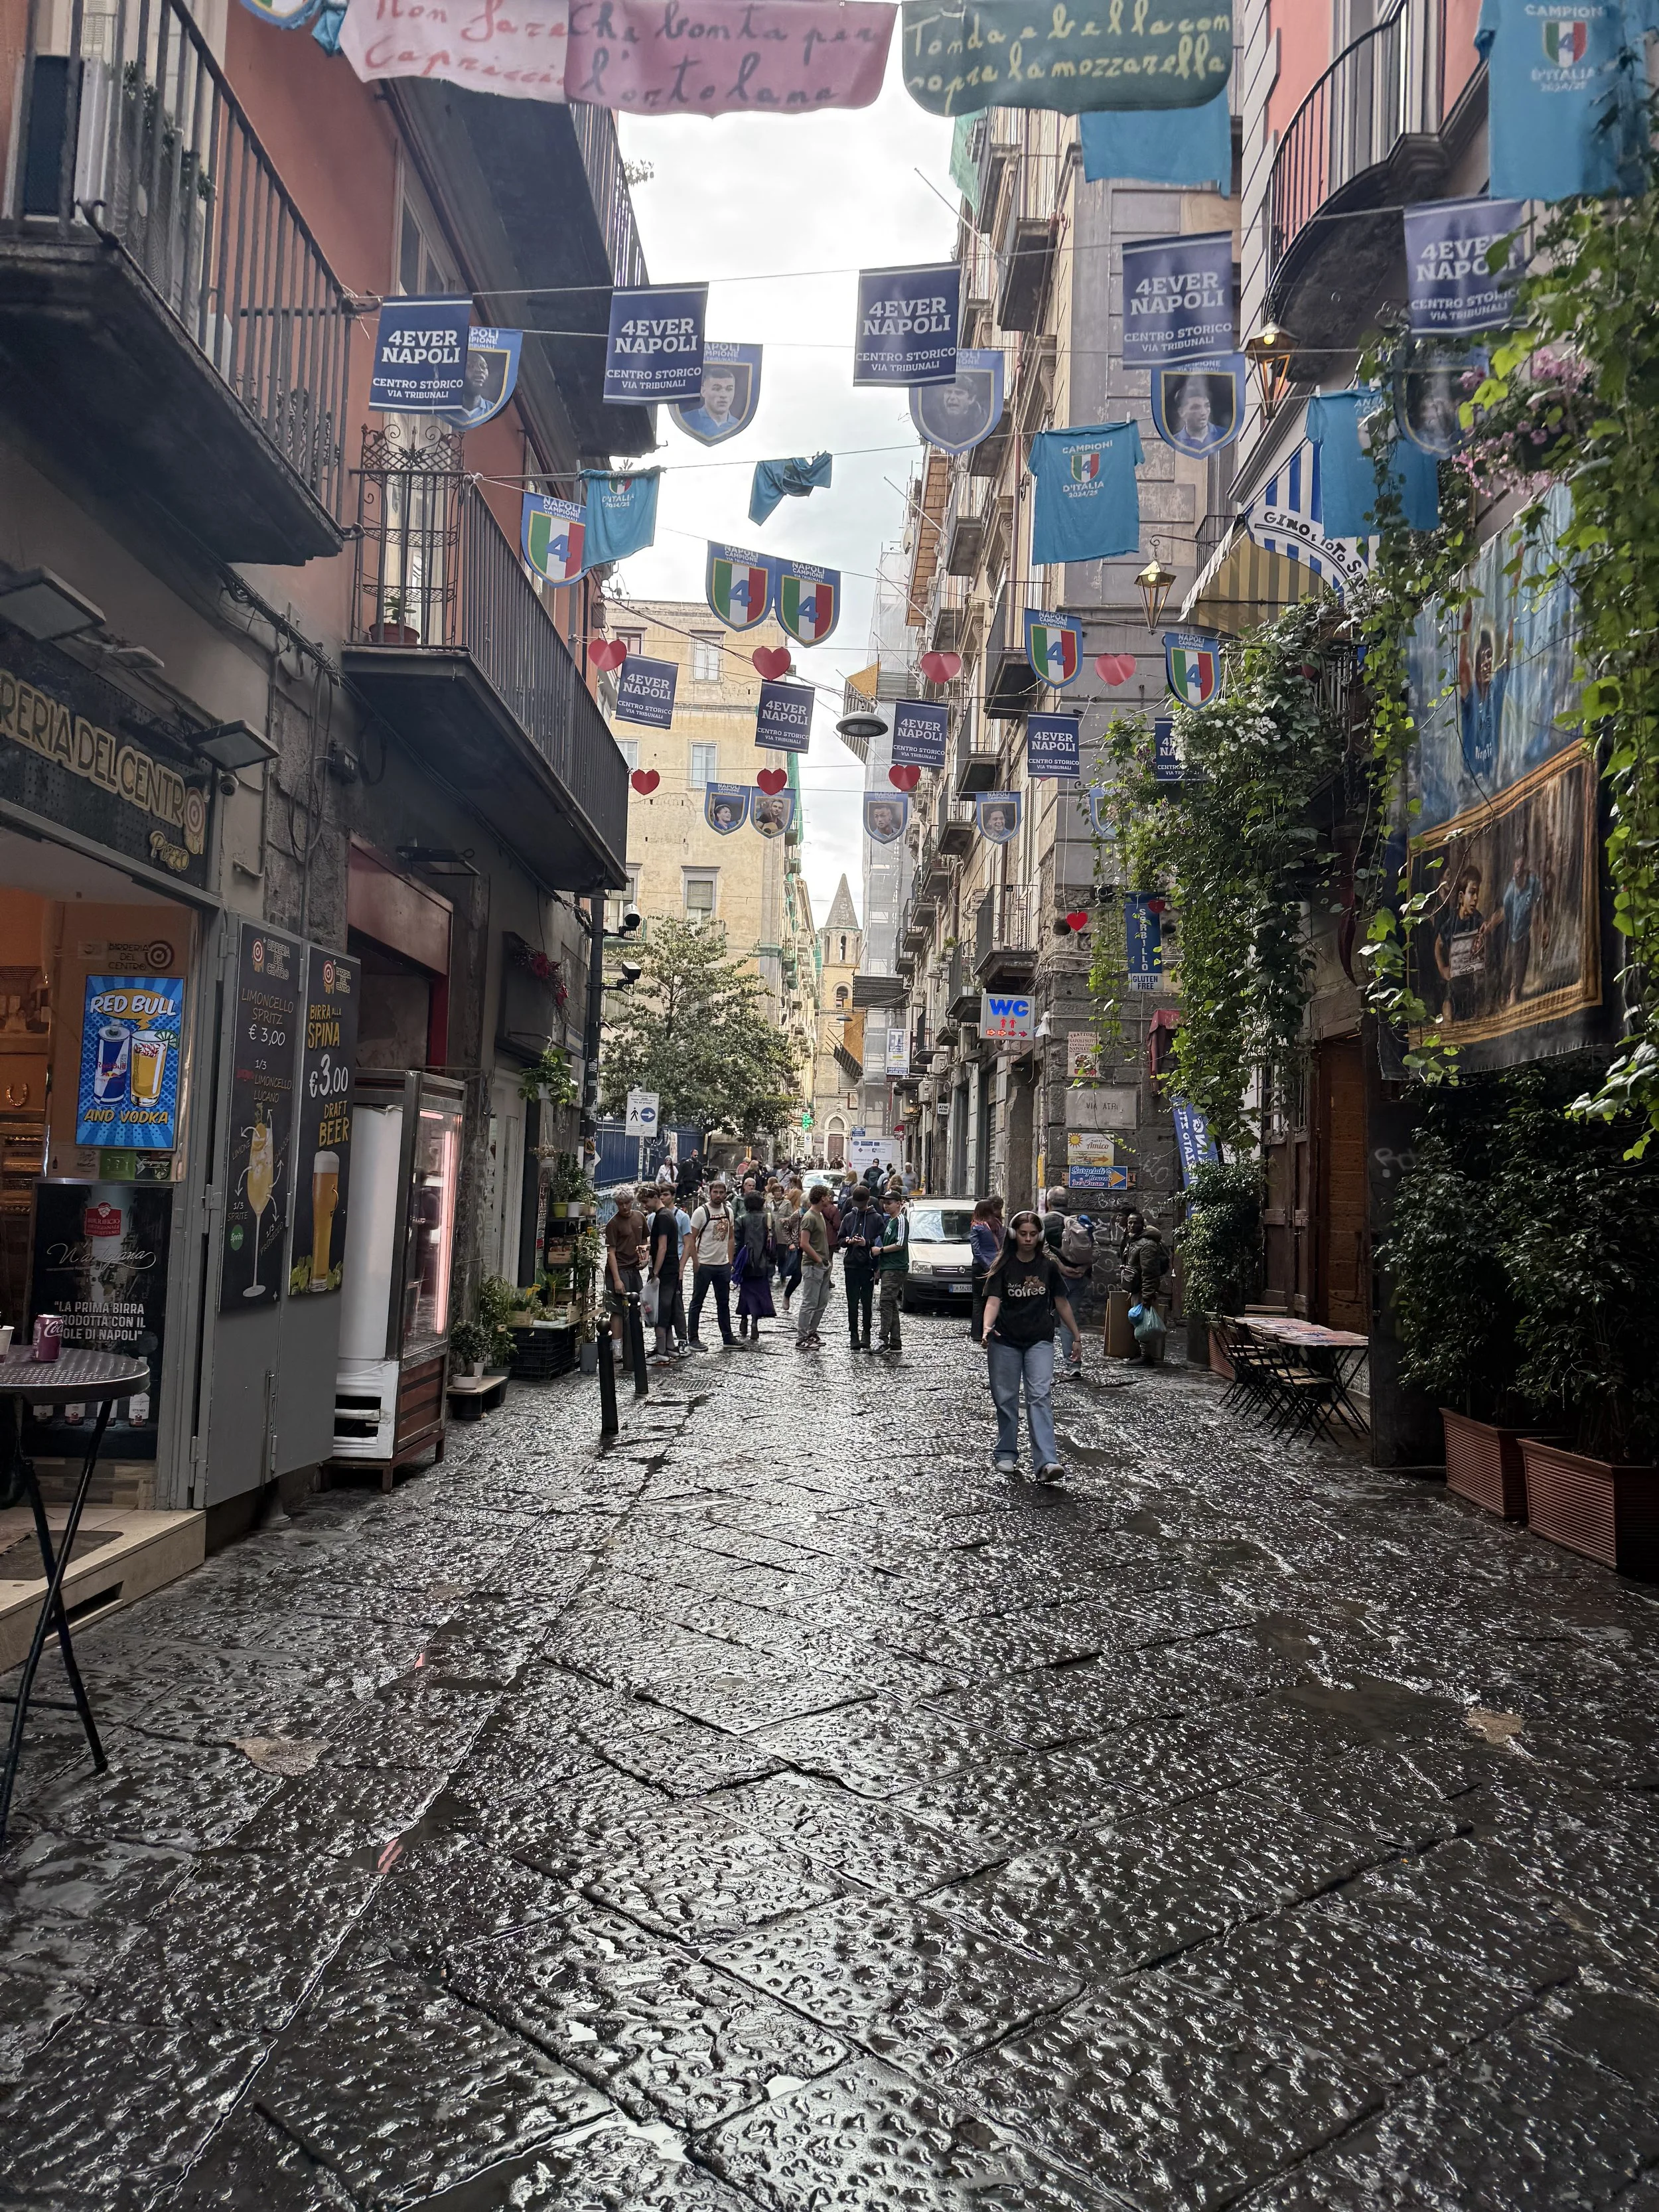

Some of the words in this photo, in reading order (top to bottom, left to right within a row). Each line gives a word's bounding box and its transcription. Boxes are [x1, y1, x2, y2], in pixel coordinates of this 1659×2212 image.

[569, 1, 639, 43] Che
[905, 13, 1007, 57] Tonda
[1047, 0, 1173, 40] bella
[1421, 233, 1509, 261] 4EVE
[1135, 271, 1219, 295] 4EVER
[869, 297, 946, 317] 4EVER
[1131, 289, 1224, 316] NAPOLI
[1411, 298, 1463, 310] CENTRO
[1430, 311, 1447, 321] VIA
[621, 318, 694, 336] 4EVER
[863, 315, 951, 336] NAPOLI
[1124, 331, 1174, 342] CENTRO
[1177, 323, 1232, 338] STORICO
[388, 331, 458, 346] 4EVER
[614, 335, 698, 354] NAPOLI
[1161, 336, 1214, 351] TRIBUNALI
[705, 342, 741, 352] APOLI
[857, 352, 903, 362] CENTRO
[906, 347, 956, 361] STORICO
[382, 347, 461, 364] NAPOLI
[607, 370, 652, 379] CENTRO
[656, 368, 701, 379] STORICO
[890, 361, 940, 372] TRIBUNALI
[373, 378, 417, 388] CENTRO
[420, 380, 463, 390] STORICO
[640, 380, 686, 390] TRIBUNALI
[1062, 439, 1114, 454] CAMPIONI
[1062, 480, 1105, 492] D'ITALIA
[543, 497, 581, 514] NAPOLI
[543, 504, 579, 518] CAMPIONE
[1263, 512, 1311, 536] GINO
[546, 534, 573, 563] 4
[725, 545, 758, 558] NAPOLI
[725, 551, 758, 563] CAMPIONE
[792, 561, 825, 575] NAPOLI
[792, 568, 824, 579] CAMPIONE
[729, 579, 753, 607] 4
[797, 595, 820, 623] 4
[1039, 611, 1067, 622] NAPOLI
[1039, 617, 1067, 626] CAMPIONE
[1178, 634, 1204, 645] NAPOLI
[1046, 641, 1066, 666] 4
[627, 674, 670, 690] 4EVER
[1185, 664, 1203, 688] 4
[622, 682, 672, 700] NAPOLI
[617, 700, 644, 710] CENTRO
[645, 705, 672, 715] STORICO
[636, 710, 663, 719] TRIBUNALI
[766, 700, 807, 715] 4EVER
[762, 709, 808, 725] NAPOLI
[901, 718, 941, 731] 4EVER
[757, 727, 782, 736] CENTRO
[897, 727, 942, 741] NAPOLI
[1034, 731, 1073, 742] 4EVER
[1031, 741, 1076, 752] NAPOLI
[78, 723, 117, 786] DEL
[1139, 909, 1149, 971] SORBILLO
[108, 962, 147, 970] CENTRO
[90, 994, 128, 1014] RED
[131, 994, 177, 1017] BULL
[242, 988, 294, 1013] LIMONCELLO
[989, 998, 1029, 1017] WC
[252, 1007, 283, 1025] SPRITZ
[310, 1004, 330, 1021] BIRRA
[261, 1027, 285, 1046] 3,00
[308, 1022, 340, 1049] SPINA
[255, 1059, 267, 1070] 1/3
[254, 1076, 292, 1090] LIMONCELLO
[253, 1090, 279, 1104] LUCANO
[84, 1109, 115, 1123] AND
[119, 1110, 169, 1125] VODKA
[324, 1100, 348, 1120] DRAFT
[319, 1117, 349, 1147] BEER
[75, 1301, 109, 1313] PRIMA
[112, 1303, 145, 1315] BIRRA
[62, 1315, 110, 1327] RODOTTA
[111, 1316, 133, 1327] CON
[137, 1317, 146, 1328] IL
[62, 1328, 82, 1339] OLE
[85, 1329, 96, 1340] DI
[98, 1329, 143, 1341] NAPOLI"
